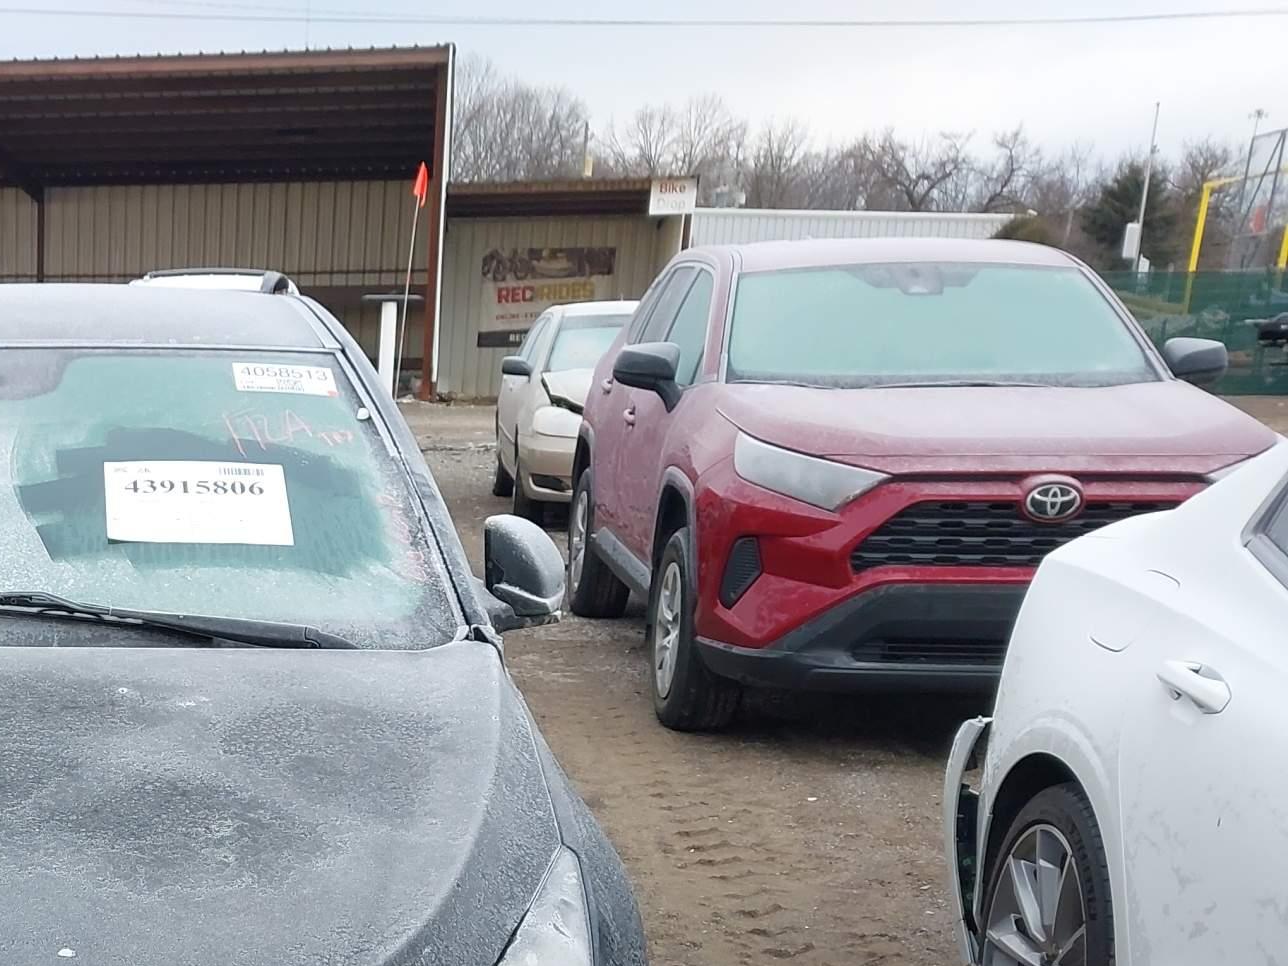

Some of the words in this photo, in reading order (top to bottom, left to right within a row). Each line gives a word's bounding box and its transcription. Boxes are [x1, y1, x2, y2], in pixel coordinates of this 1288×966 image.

[659, 182, 686, 193] Bike
[497, 286, 534, 304] REC
[538, 282, 594, 299] RIDES
[240, 366, 328, 381] 4058513
[124, 479, 265, 496] 43915806
